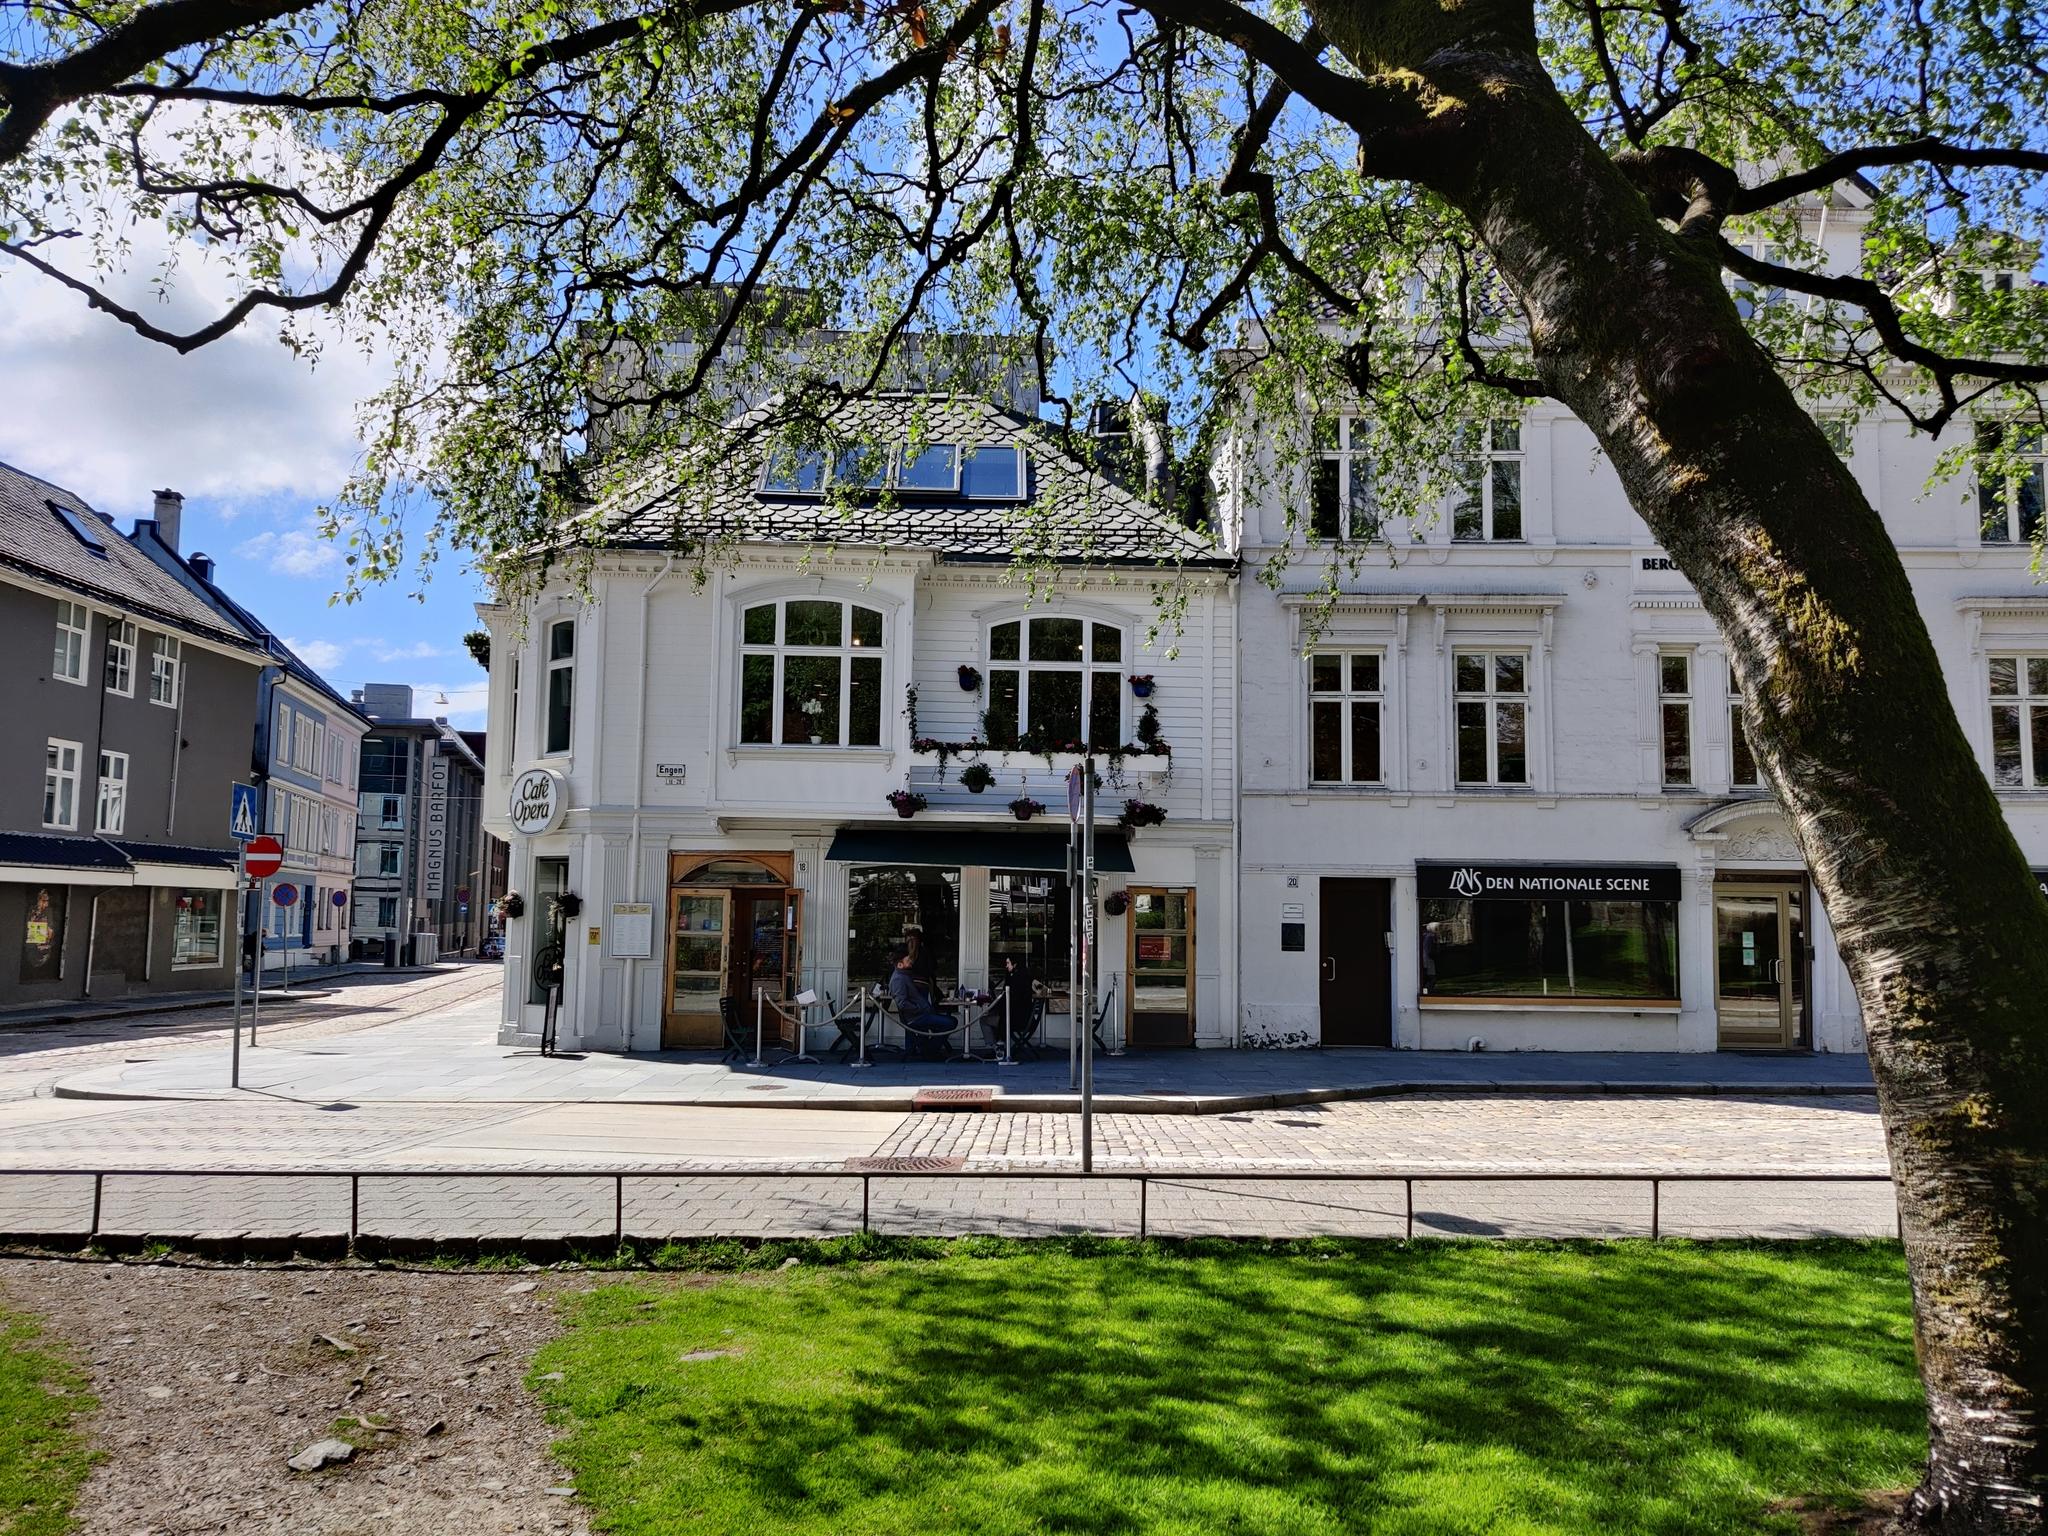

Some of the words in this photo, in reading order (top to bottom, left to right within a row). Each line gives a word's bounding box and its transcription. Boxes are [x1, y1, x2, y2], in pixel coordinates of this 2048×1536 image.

[659, 765, 683, 776] Engen
[431, 763, 446, 823] BARFOT
[522, 775, 550, 801] Café
[513, 800, 550, 826] Opera
[427, 829, 443, 891] MAGNUS
[799, 862, 806, 871] 18
[1288, 877, 1297, 886] 20
[1486, 878, 1514, 890] DEN
[1519, 878, 1602, 891] NATIONALE
[1606, 878, 1650, 891] SCENE
